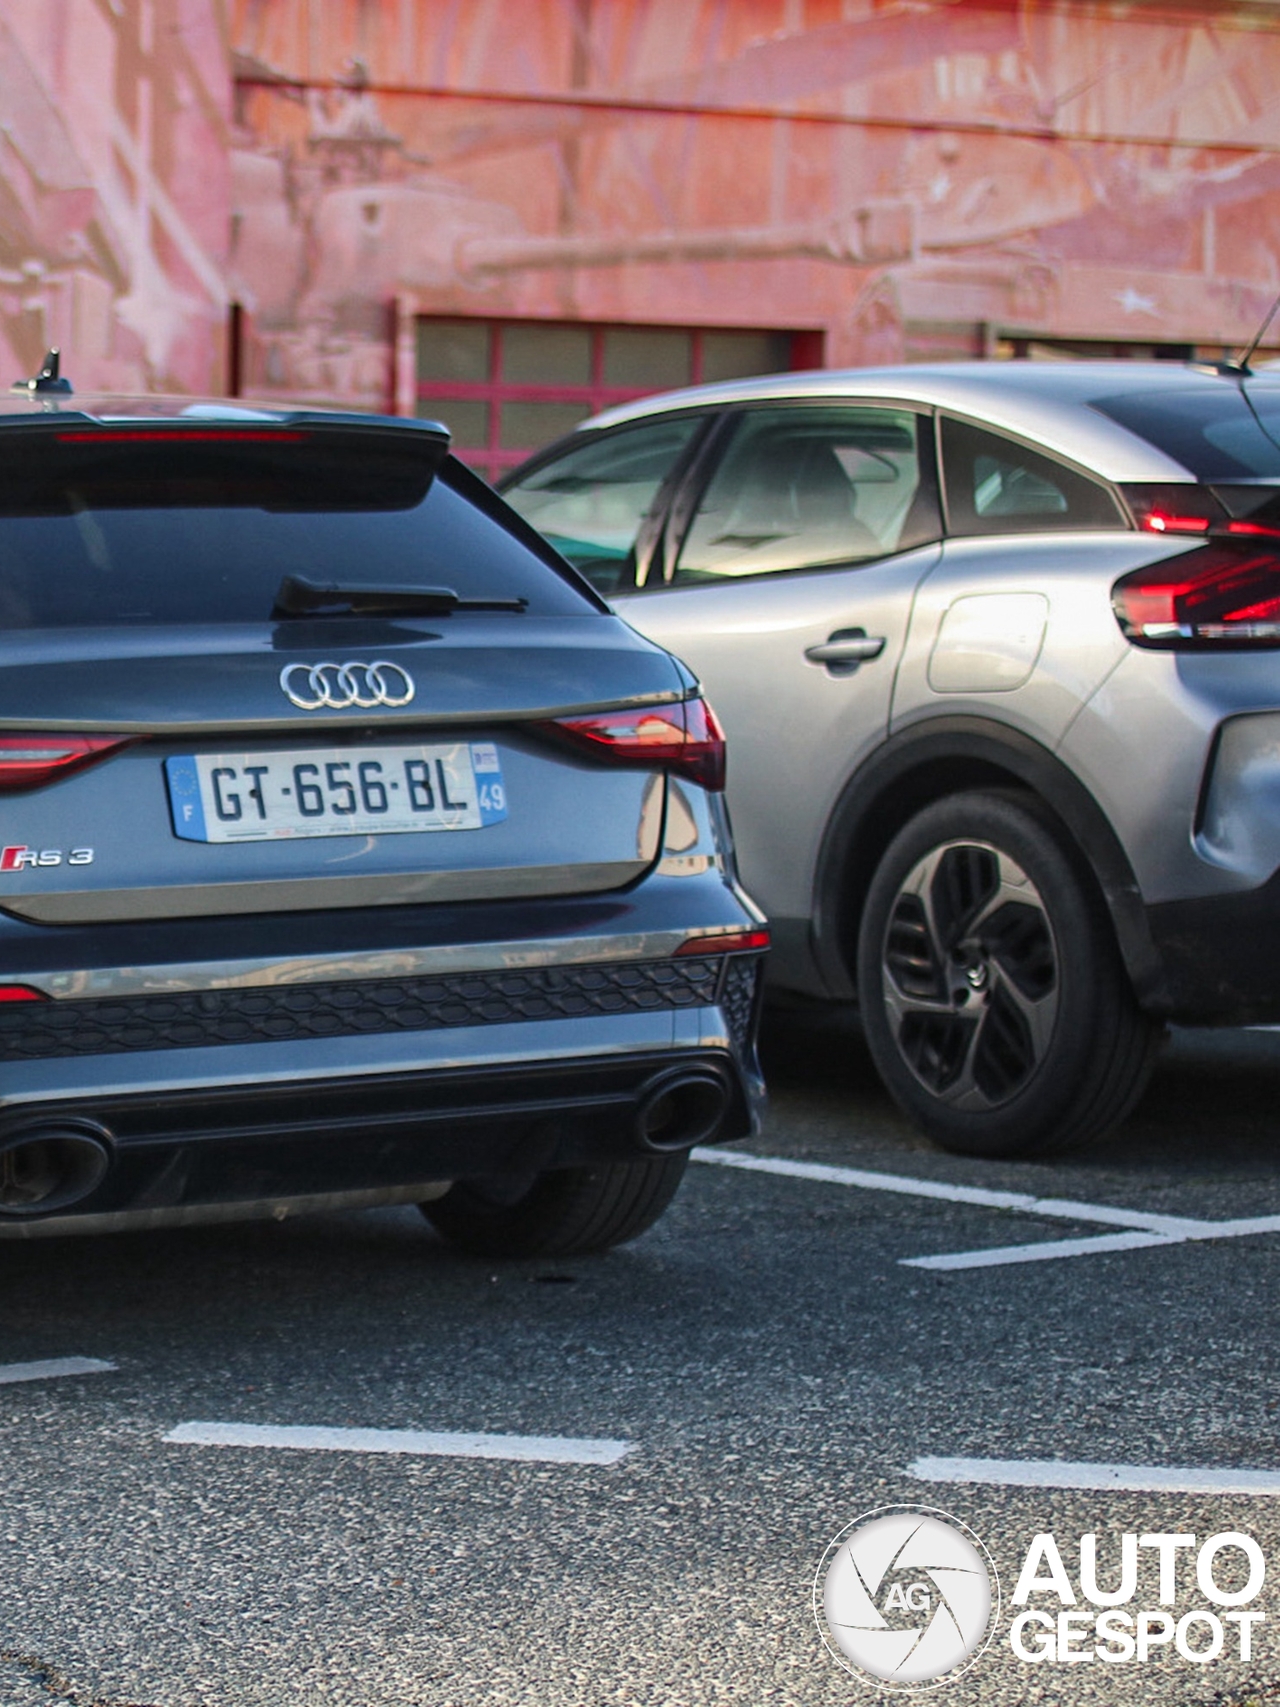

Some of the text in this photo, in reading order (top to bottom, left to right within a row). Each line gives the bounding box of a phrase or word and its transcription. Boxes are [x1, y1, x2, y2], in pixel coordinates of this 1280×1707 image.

[480, 784, 504, 810] 49
[183, 805, 192, 822] F
[10, 848, 94, 868] RS 3
